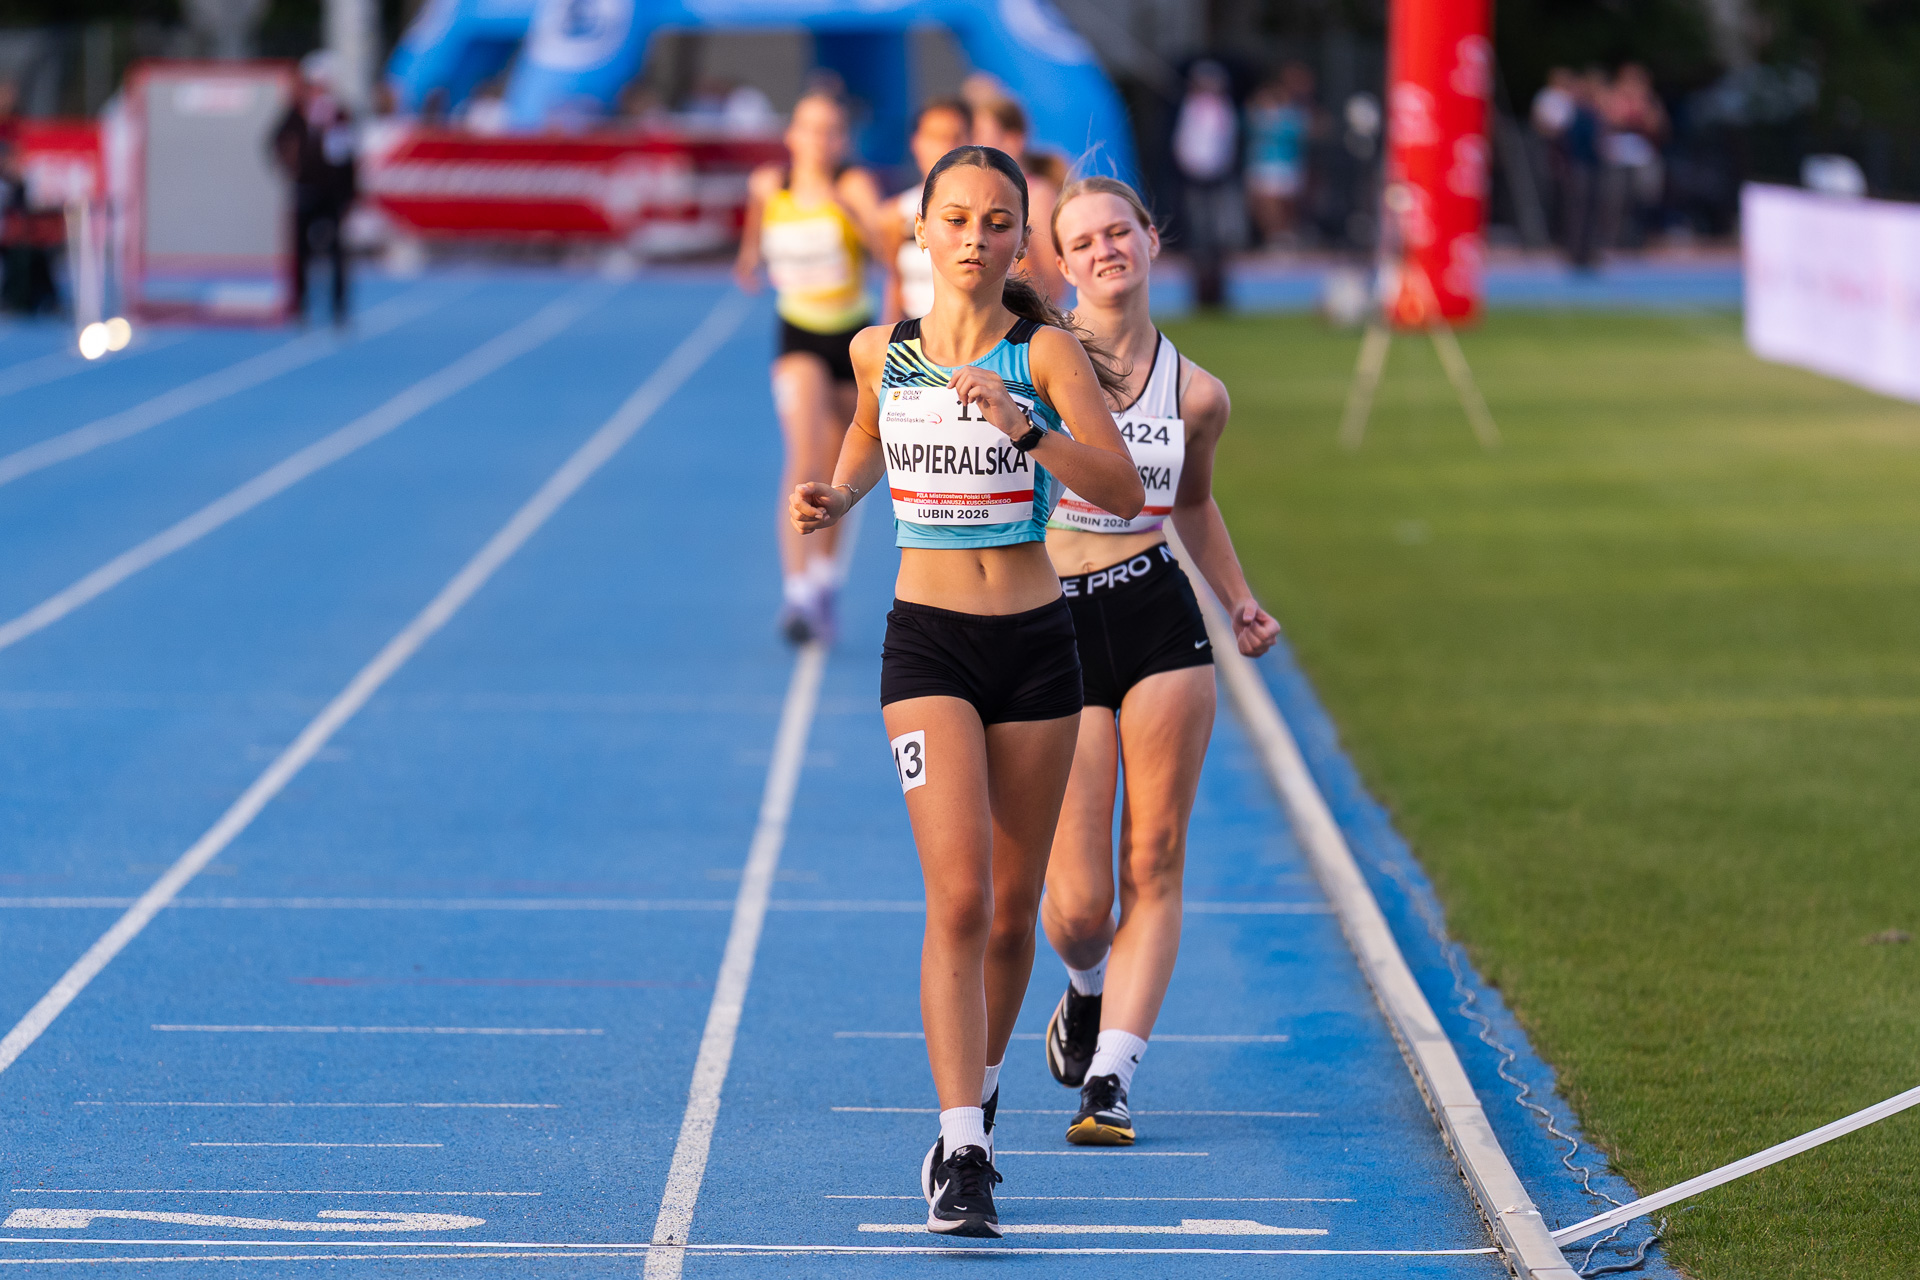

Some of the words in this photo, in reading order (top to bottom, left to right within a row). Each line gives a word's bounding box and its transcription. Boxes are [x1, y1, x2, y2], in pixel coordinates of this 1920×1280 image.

[887, 443, 1029, 475] NAPIERALSKA
[1137, 466, 1170, 490] SKA
[918, 509, 953, 519] LUBIN
[957, 510, 989, 519] 2026
[1066, 513, 1100, 527] LUBIN
[1103, 518, 1131, 528] 2026
[1087, 555, 1152, 595] PRO
[895, 741, 923, 784] 13
